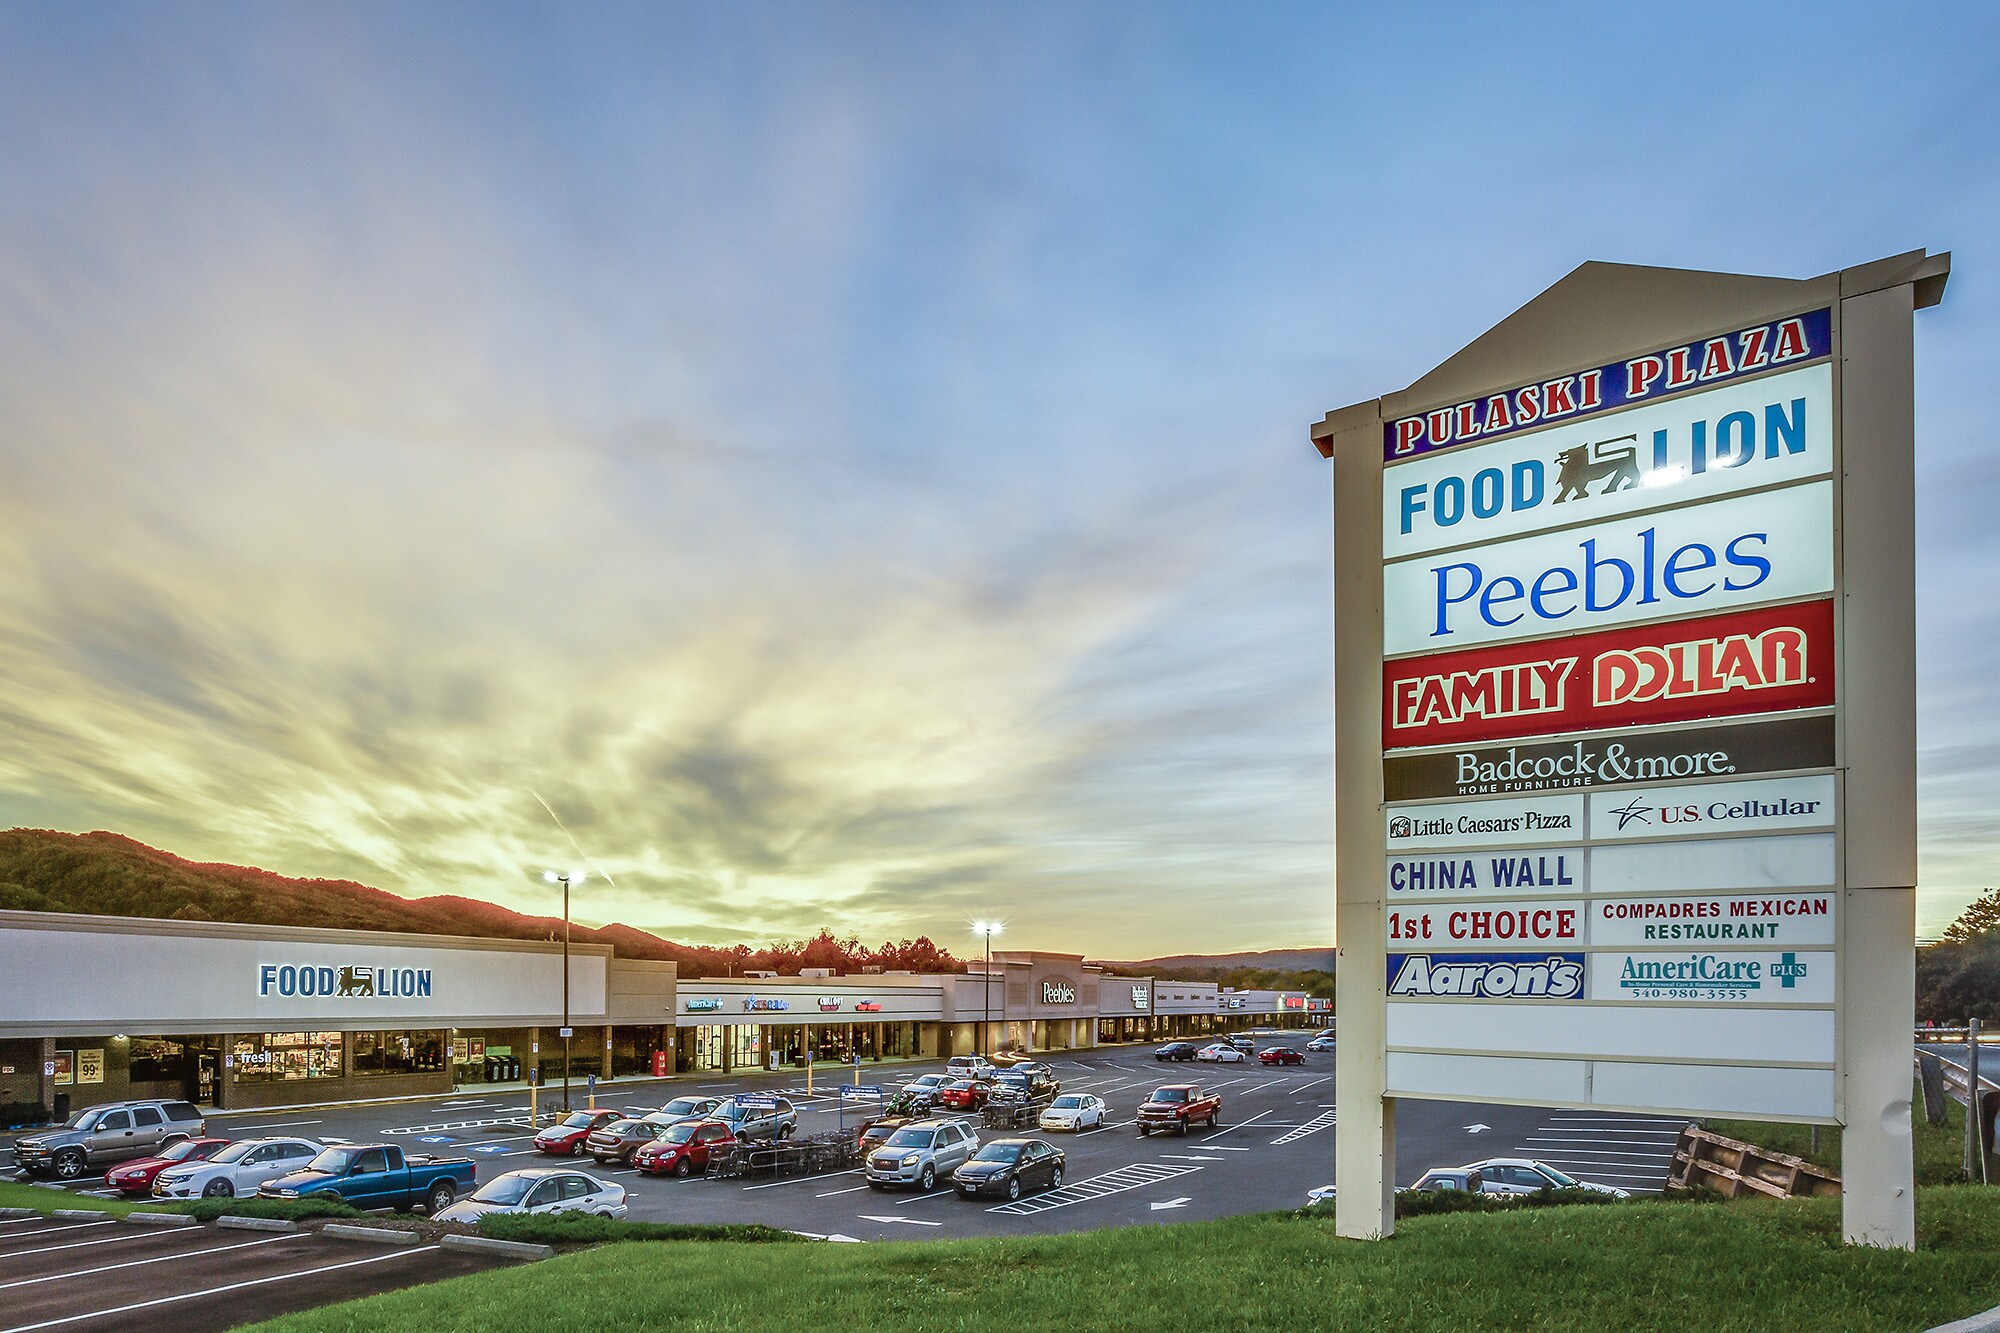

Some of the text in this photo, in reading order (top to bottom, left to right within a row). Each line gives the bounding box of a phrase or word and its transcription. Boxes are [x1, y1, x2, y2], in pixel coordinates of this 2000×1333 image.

[1395, 318, 1810, 455] PULASKI PLAZA
[1400, 397, 1807, 535] FOOD LION
[1429, 527, 1772, 637] Peebles
[1393, 626, 1808, 729] FAMILY DOLLAR
[1458, 777, 1592, 795] HOME FURNITURE
[1413, 811, 1572, 836] Little Caesars Pizza
[1660, 798, 1821, 824] U.S. Cellular
[1390, 856, 1573, 891] CHINA WALL
[1603, 899, 1828, 919] COMPADRES MEXICAN
[1389, 910, 1576, 939] 1st CHOICE
[1645, 923, 1779, 940] RESTAURANT
[1390, 954, 1582, 998] Aaron's
[1620, 954, 1807, 980] AmeriCare PLUS
[259, 965, 432, 997] FOOD LION
[1043, 982, 1075, 1003] Peebles
[1632, 988, 1748, 1000] 540-980-3555
[240, 1050, 272, 1063] fresh
